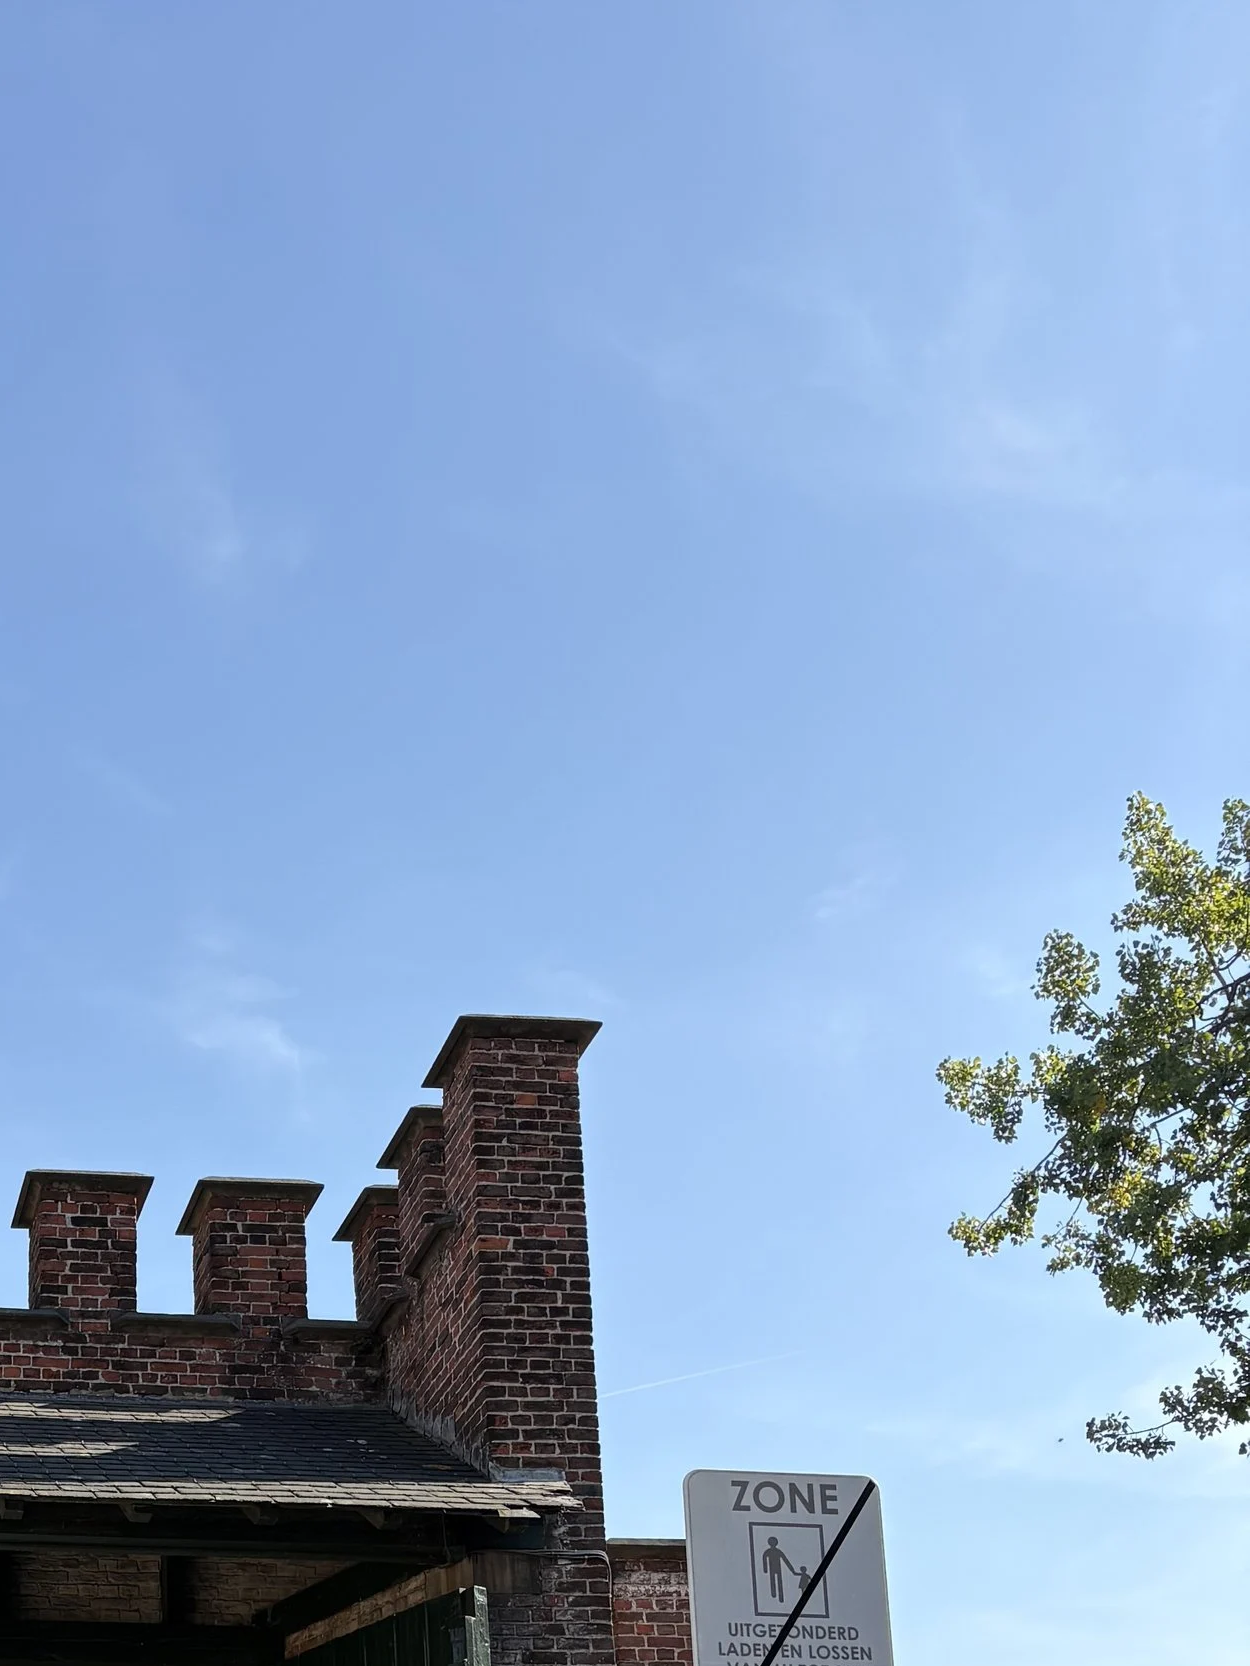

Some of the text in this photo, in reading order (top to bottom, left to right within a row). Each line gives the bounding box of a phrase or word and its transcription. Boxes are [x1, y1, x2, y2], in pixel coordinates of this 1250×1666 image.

[730, 1480, 839, 1515] ZONE
[781, 1644, 802, 1658] EN
[809, 1645, 873, 1661] LOSSEN
